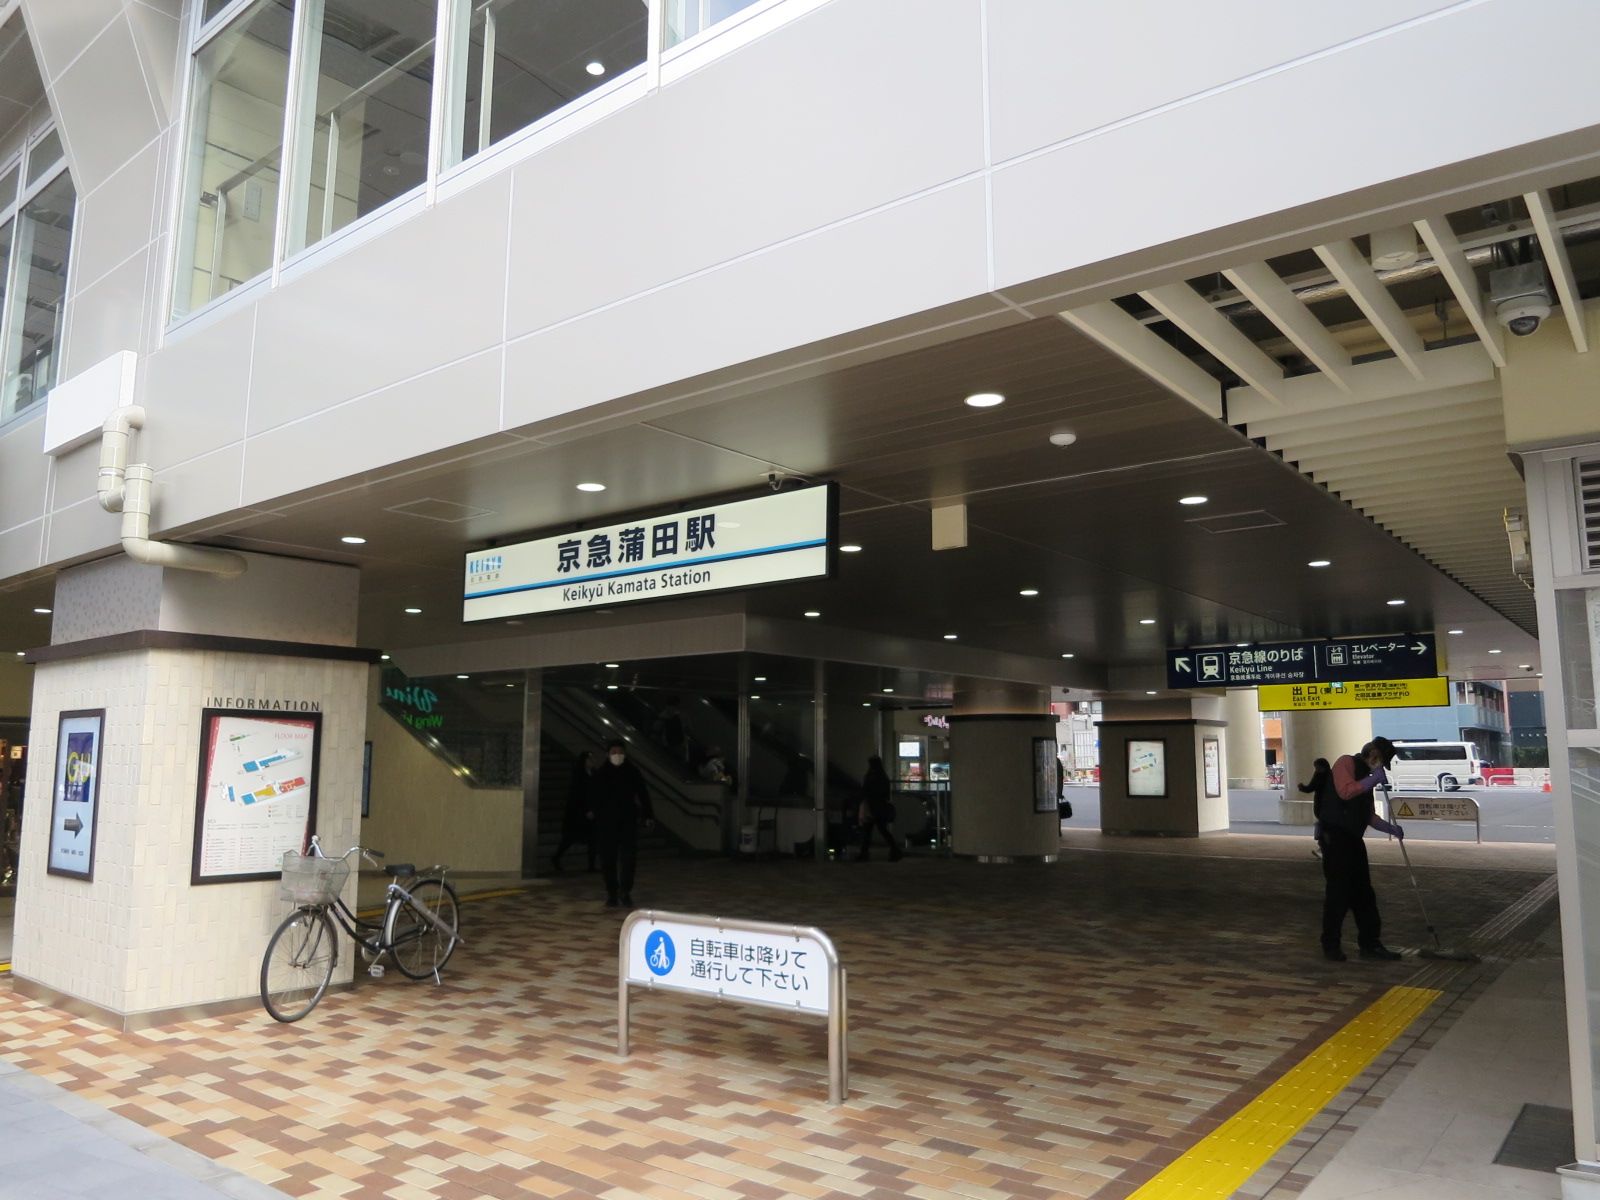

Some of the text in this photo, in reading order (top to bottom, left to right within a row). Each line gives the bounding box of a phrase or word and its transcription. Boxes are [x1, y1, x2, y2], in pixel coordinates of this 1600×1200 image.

[557, 513, 717, 573] 京急蒲田駅
[563, 568, 711, 602] Keikyū Kamata Station
[1228, 647, 1304, 665] 京急線のりば
[1351, 642, 1406, 653] エレベーター
[1256, 664, 1273, 672] Line
[206, 696, 320, 712] INFORMATION
[690, 938, 808, 969] 自転車は降りて
[690, 960, 809, 991] 通行して下さい
